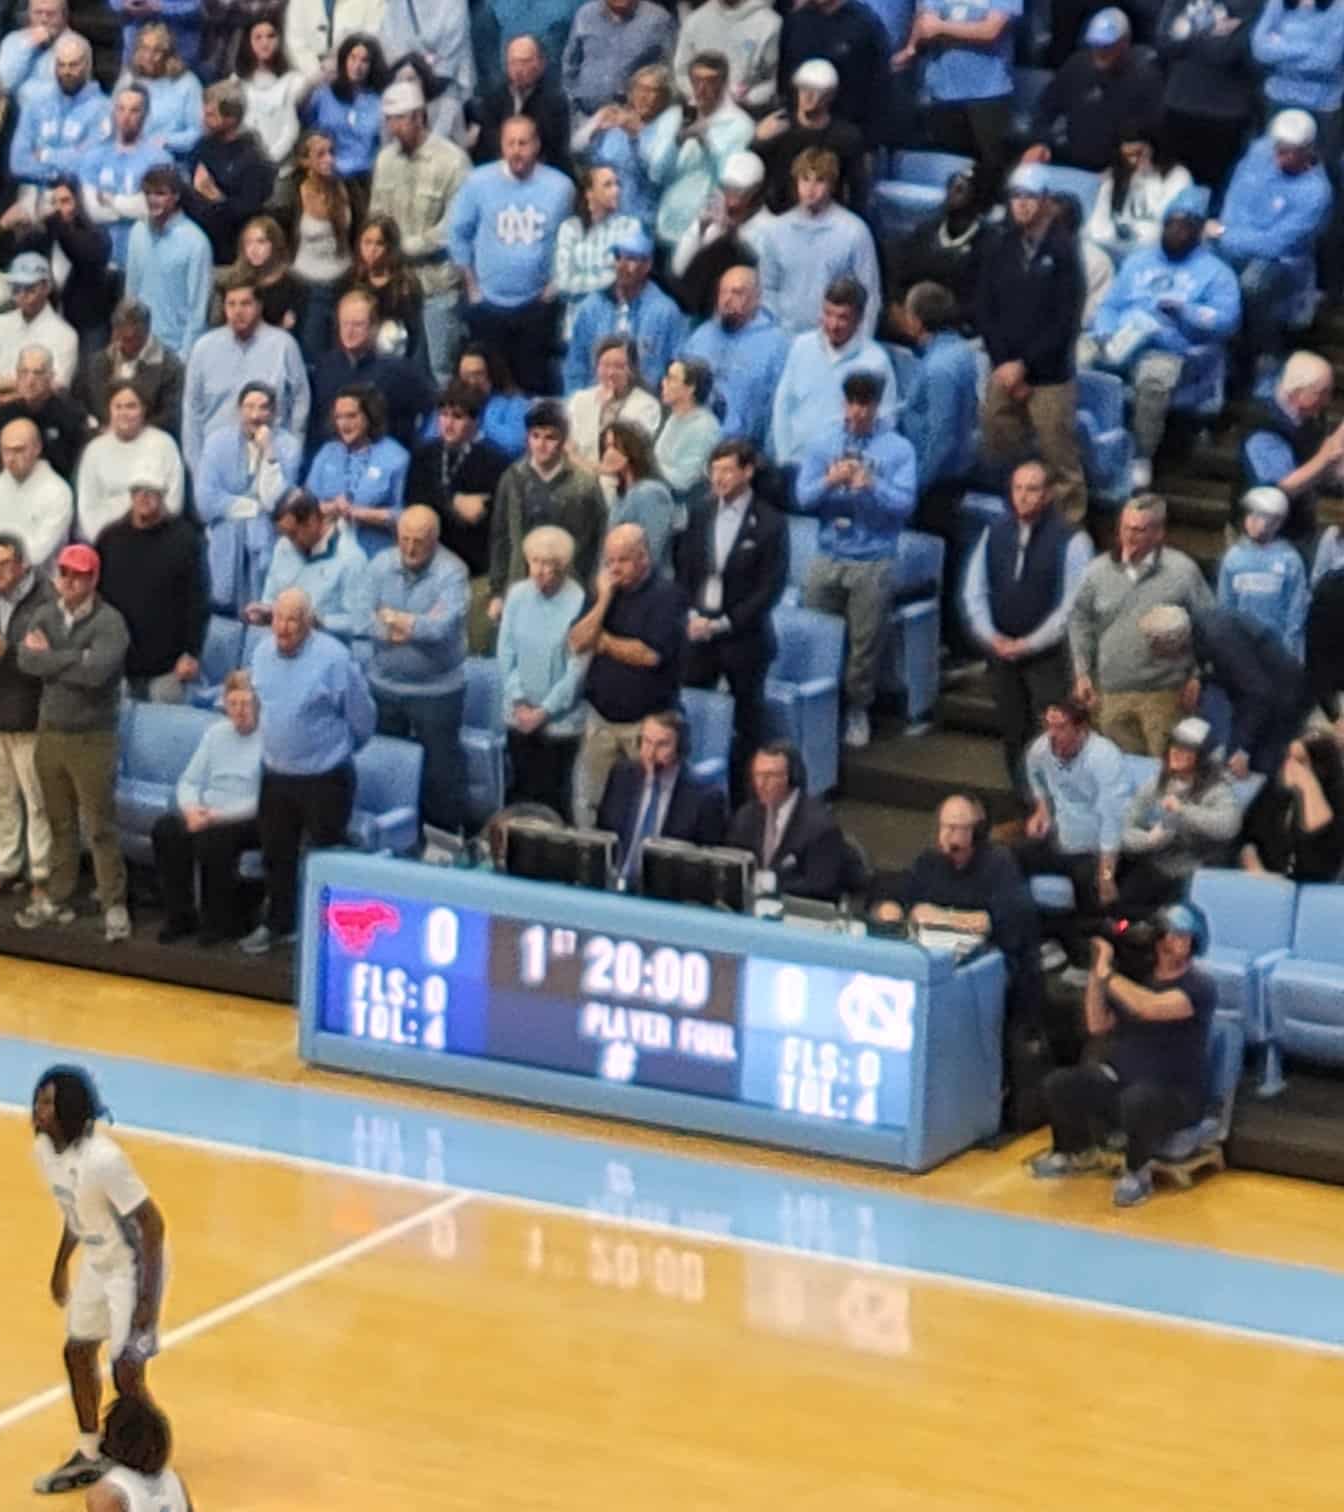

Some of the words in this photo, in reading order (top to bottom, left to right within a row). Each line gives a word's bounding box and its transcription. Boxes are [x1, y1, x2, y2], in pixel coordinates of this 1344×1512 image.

[426, 906, 459, 968] 0
[582, 934, 710, 1009] 20:00
[579, 1000, 673, 1048] PLAYER
